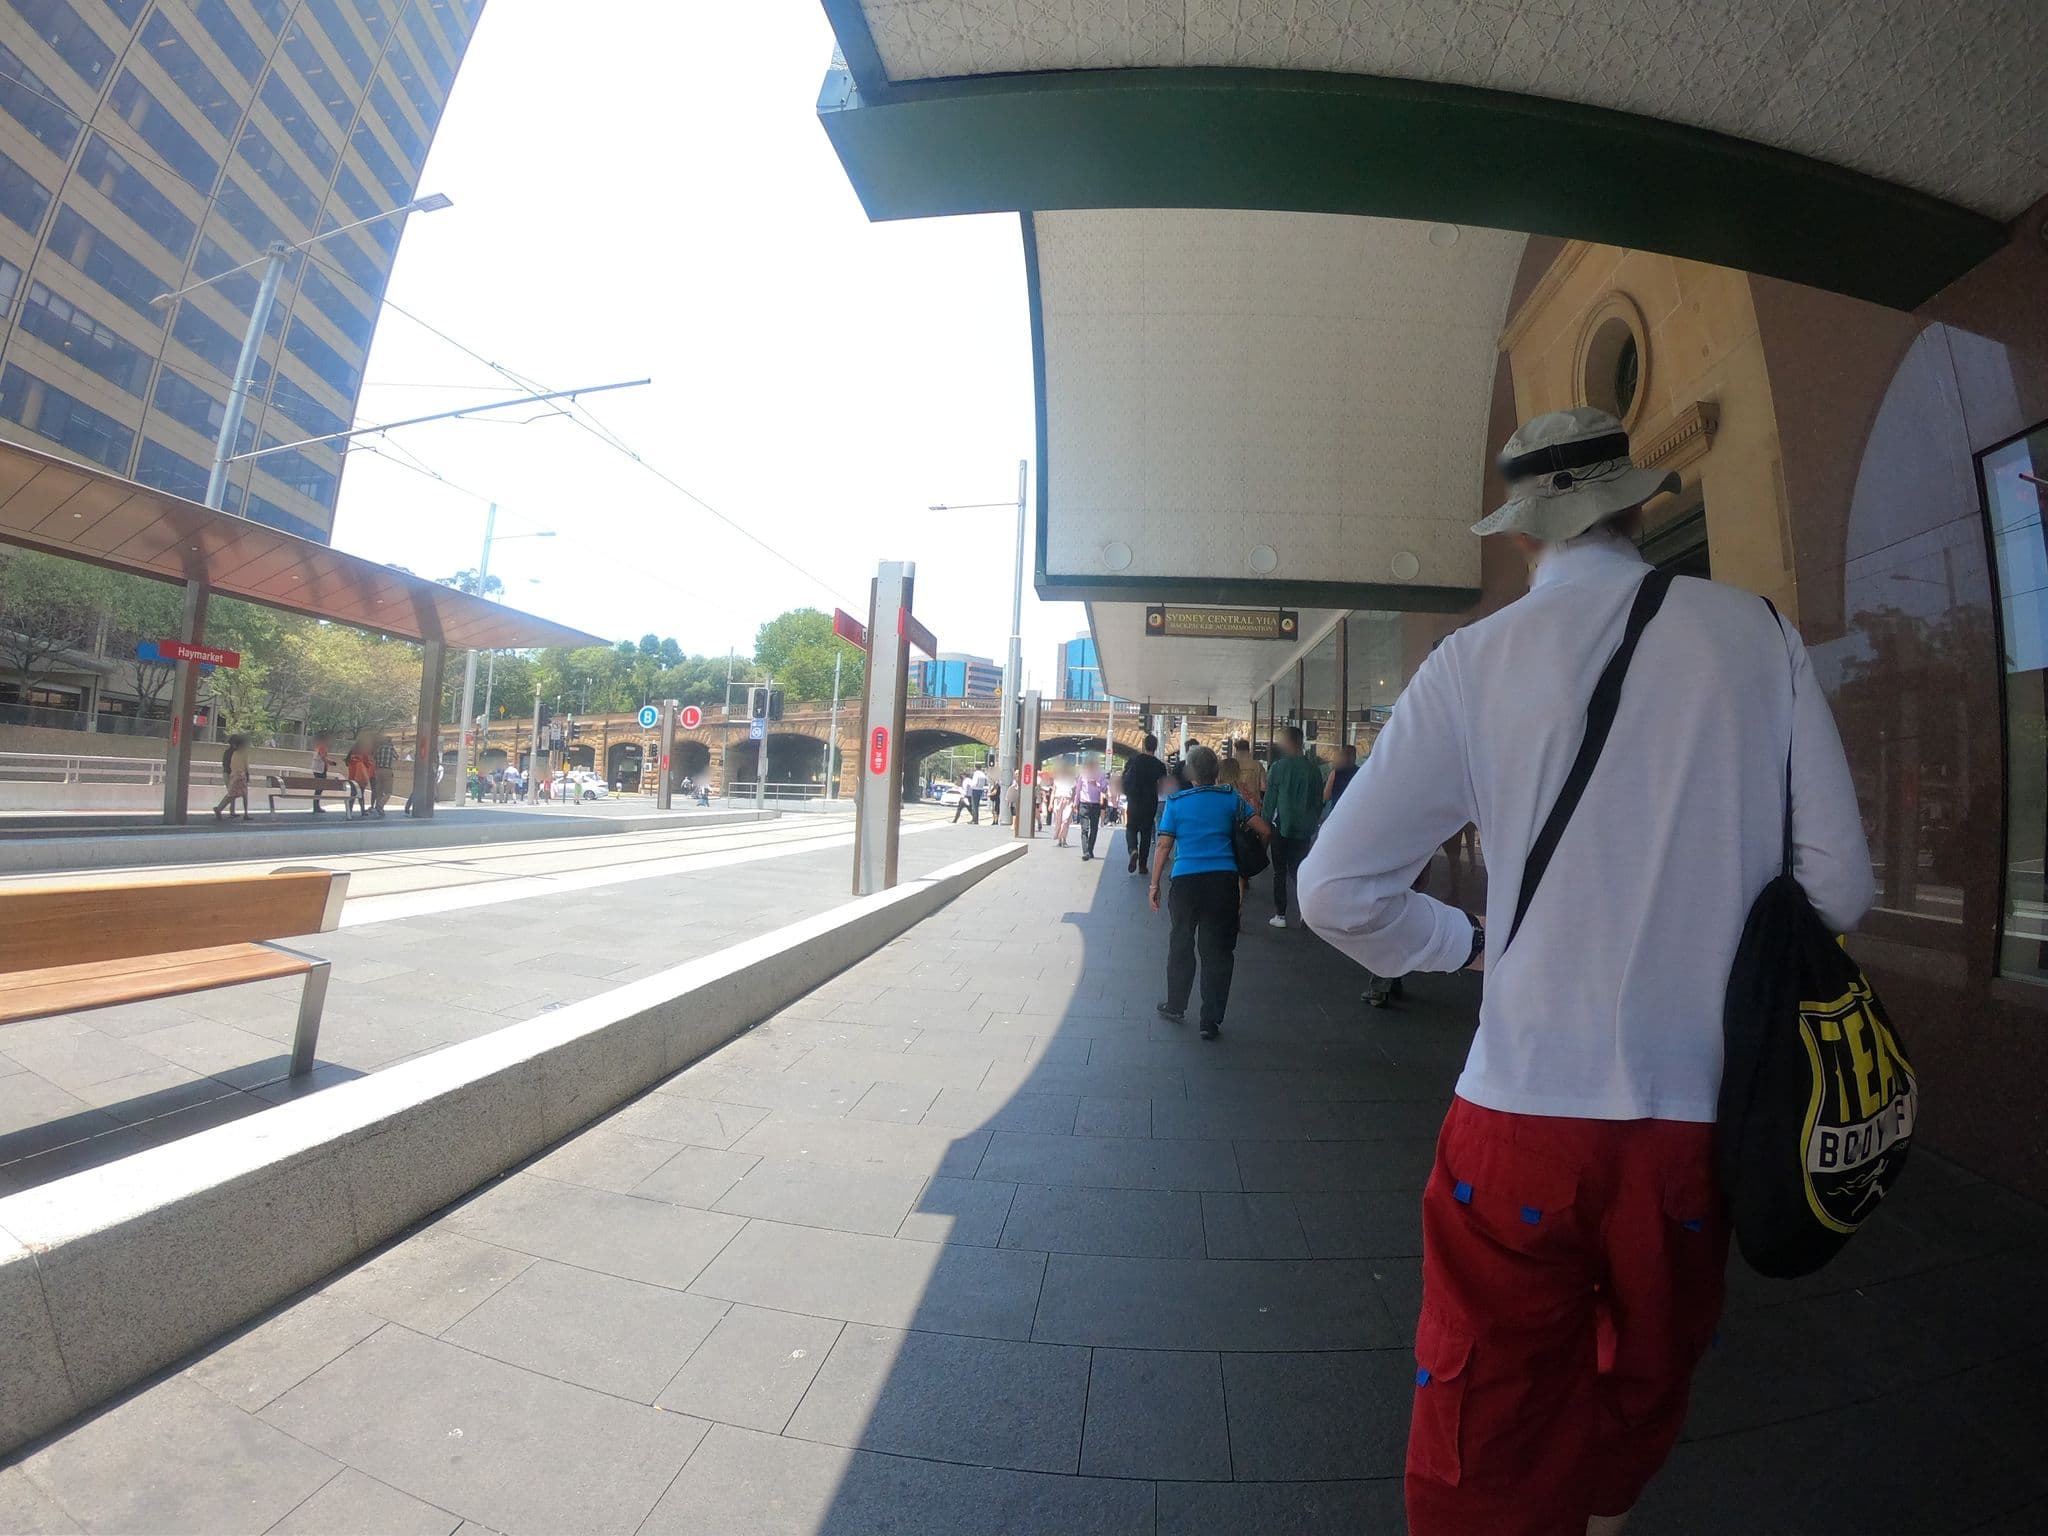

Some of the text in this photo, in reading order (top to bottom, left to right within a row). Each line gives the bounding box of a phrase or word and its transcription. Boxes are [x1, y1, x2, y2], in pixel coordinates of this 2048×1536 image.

[1166, 613, 1207, 623] SYDNEY
[1207, 614, 1253, 624] CENTRAL
[178, 646, 223, 663] Haymarket
[643, 710, 653, 724] B
[686, 710, 695, 724] L
